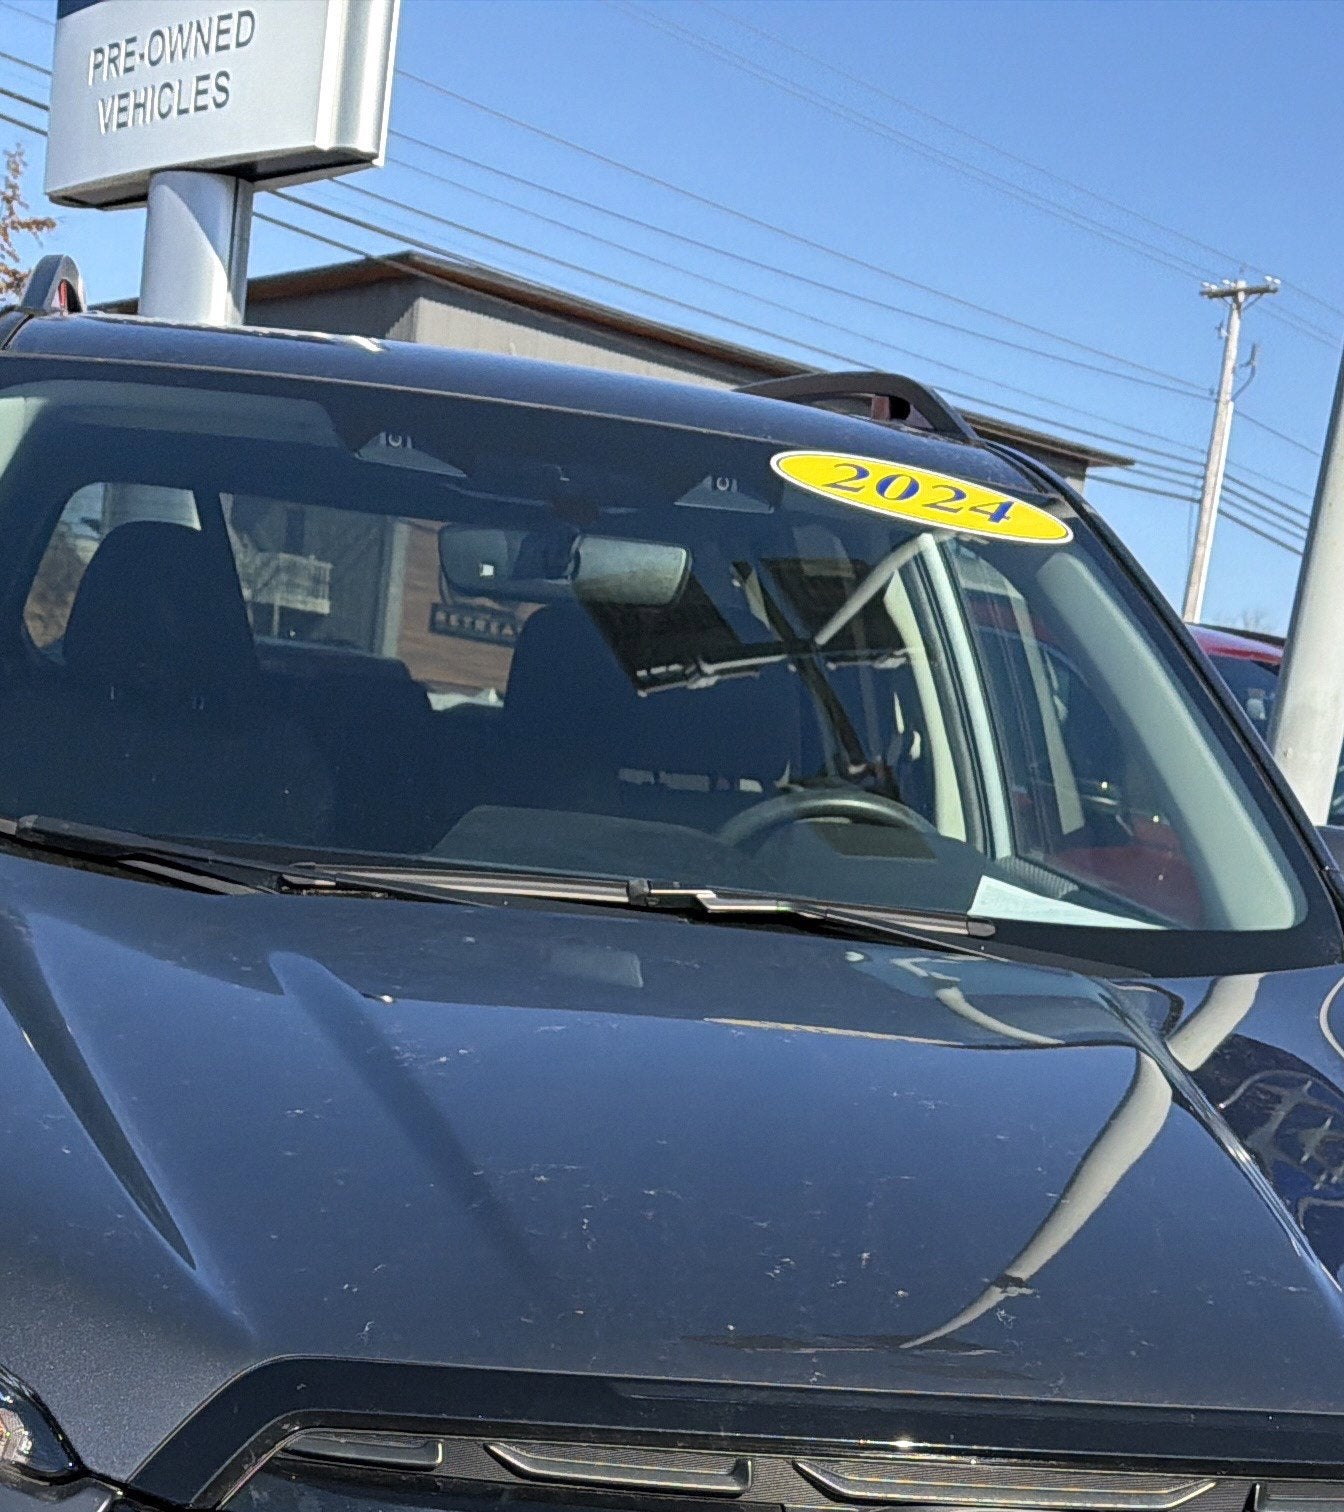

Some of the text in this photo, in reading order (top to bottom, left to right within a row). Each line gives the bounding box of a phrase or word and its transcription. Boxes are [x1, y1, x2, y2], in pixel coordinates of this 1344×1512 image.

[88, 9, 256, 86] PRE-OWNED
[98, 69, 231, 135] VEHICLES
[821, 462, 1016, 524] 2024
